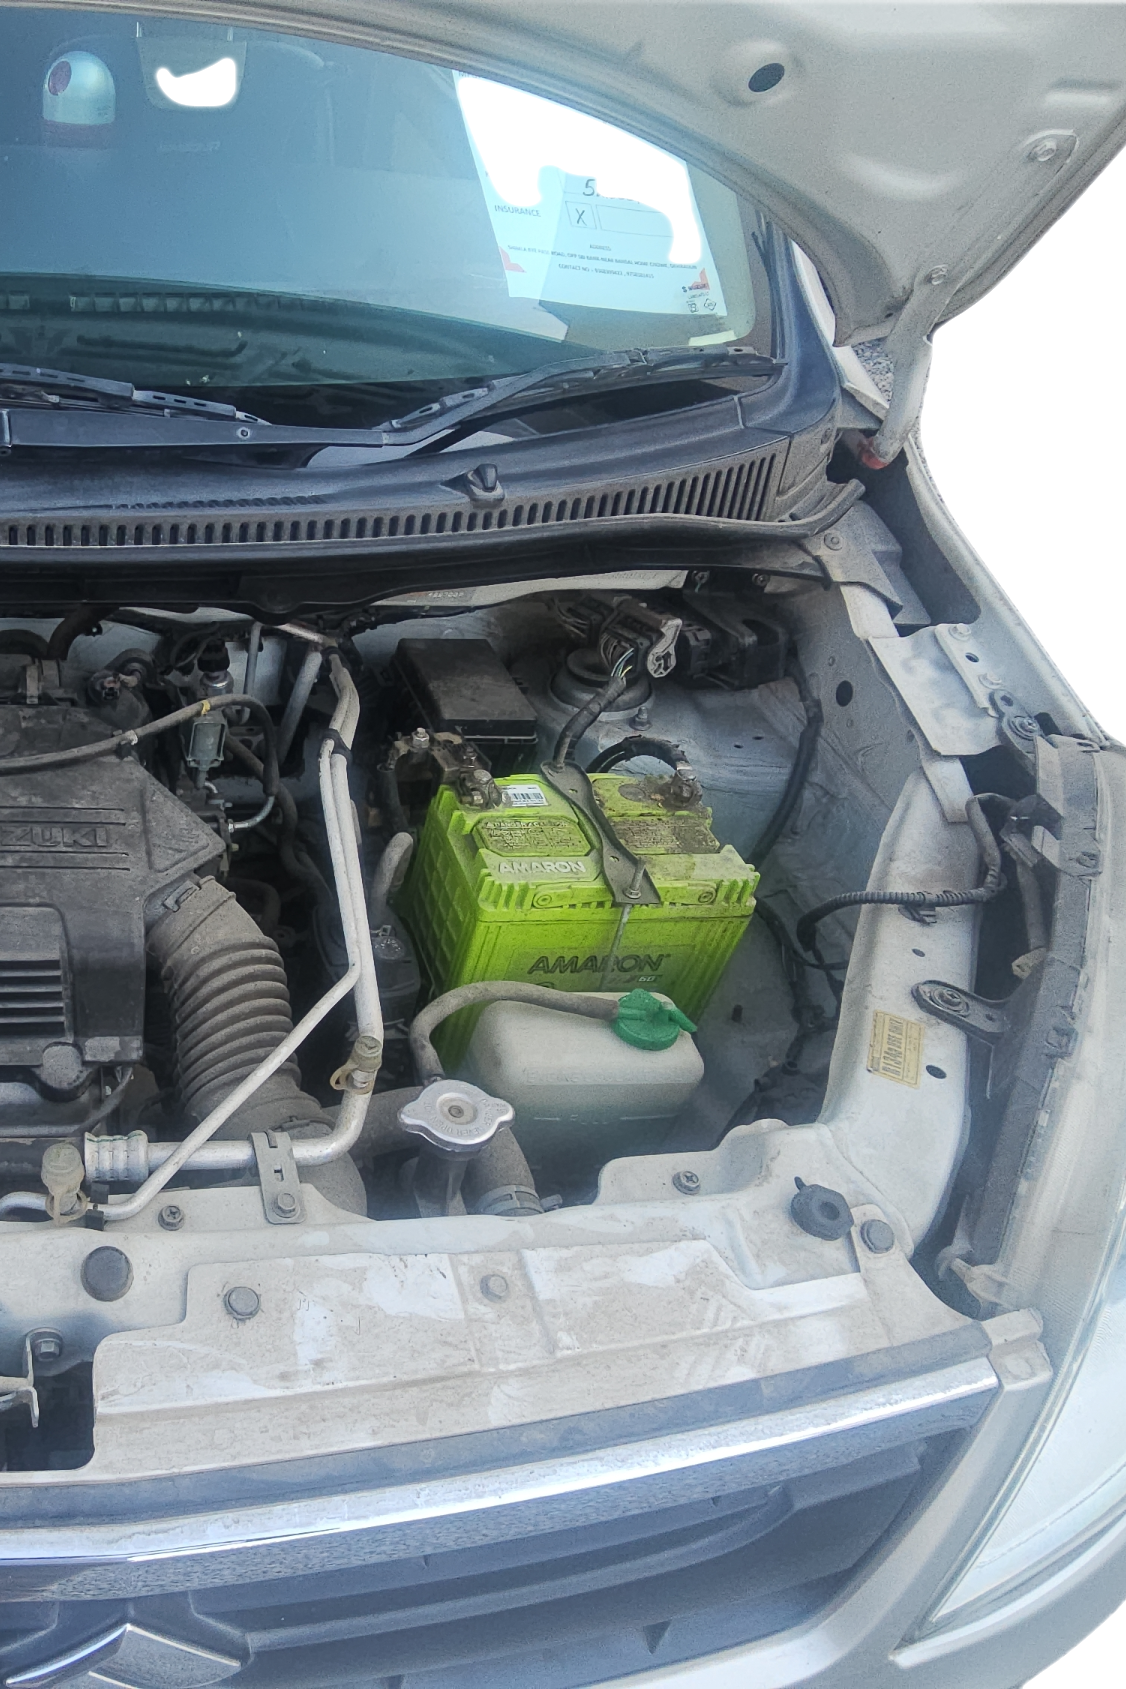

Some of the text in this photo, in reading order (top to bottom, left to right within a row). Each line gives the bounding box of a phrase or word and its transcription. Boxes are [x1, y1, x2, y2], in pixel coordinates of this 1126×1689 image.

[494, 204, 542, 218] INSURANCE
[575, 207, 587, 226] X
[499, 861, 586, 873] AMARON
[527, 953, 665, 975] AMARON
